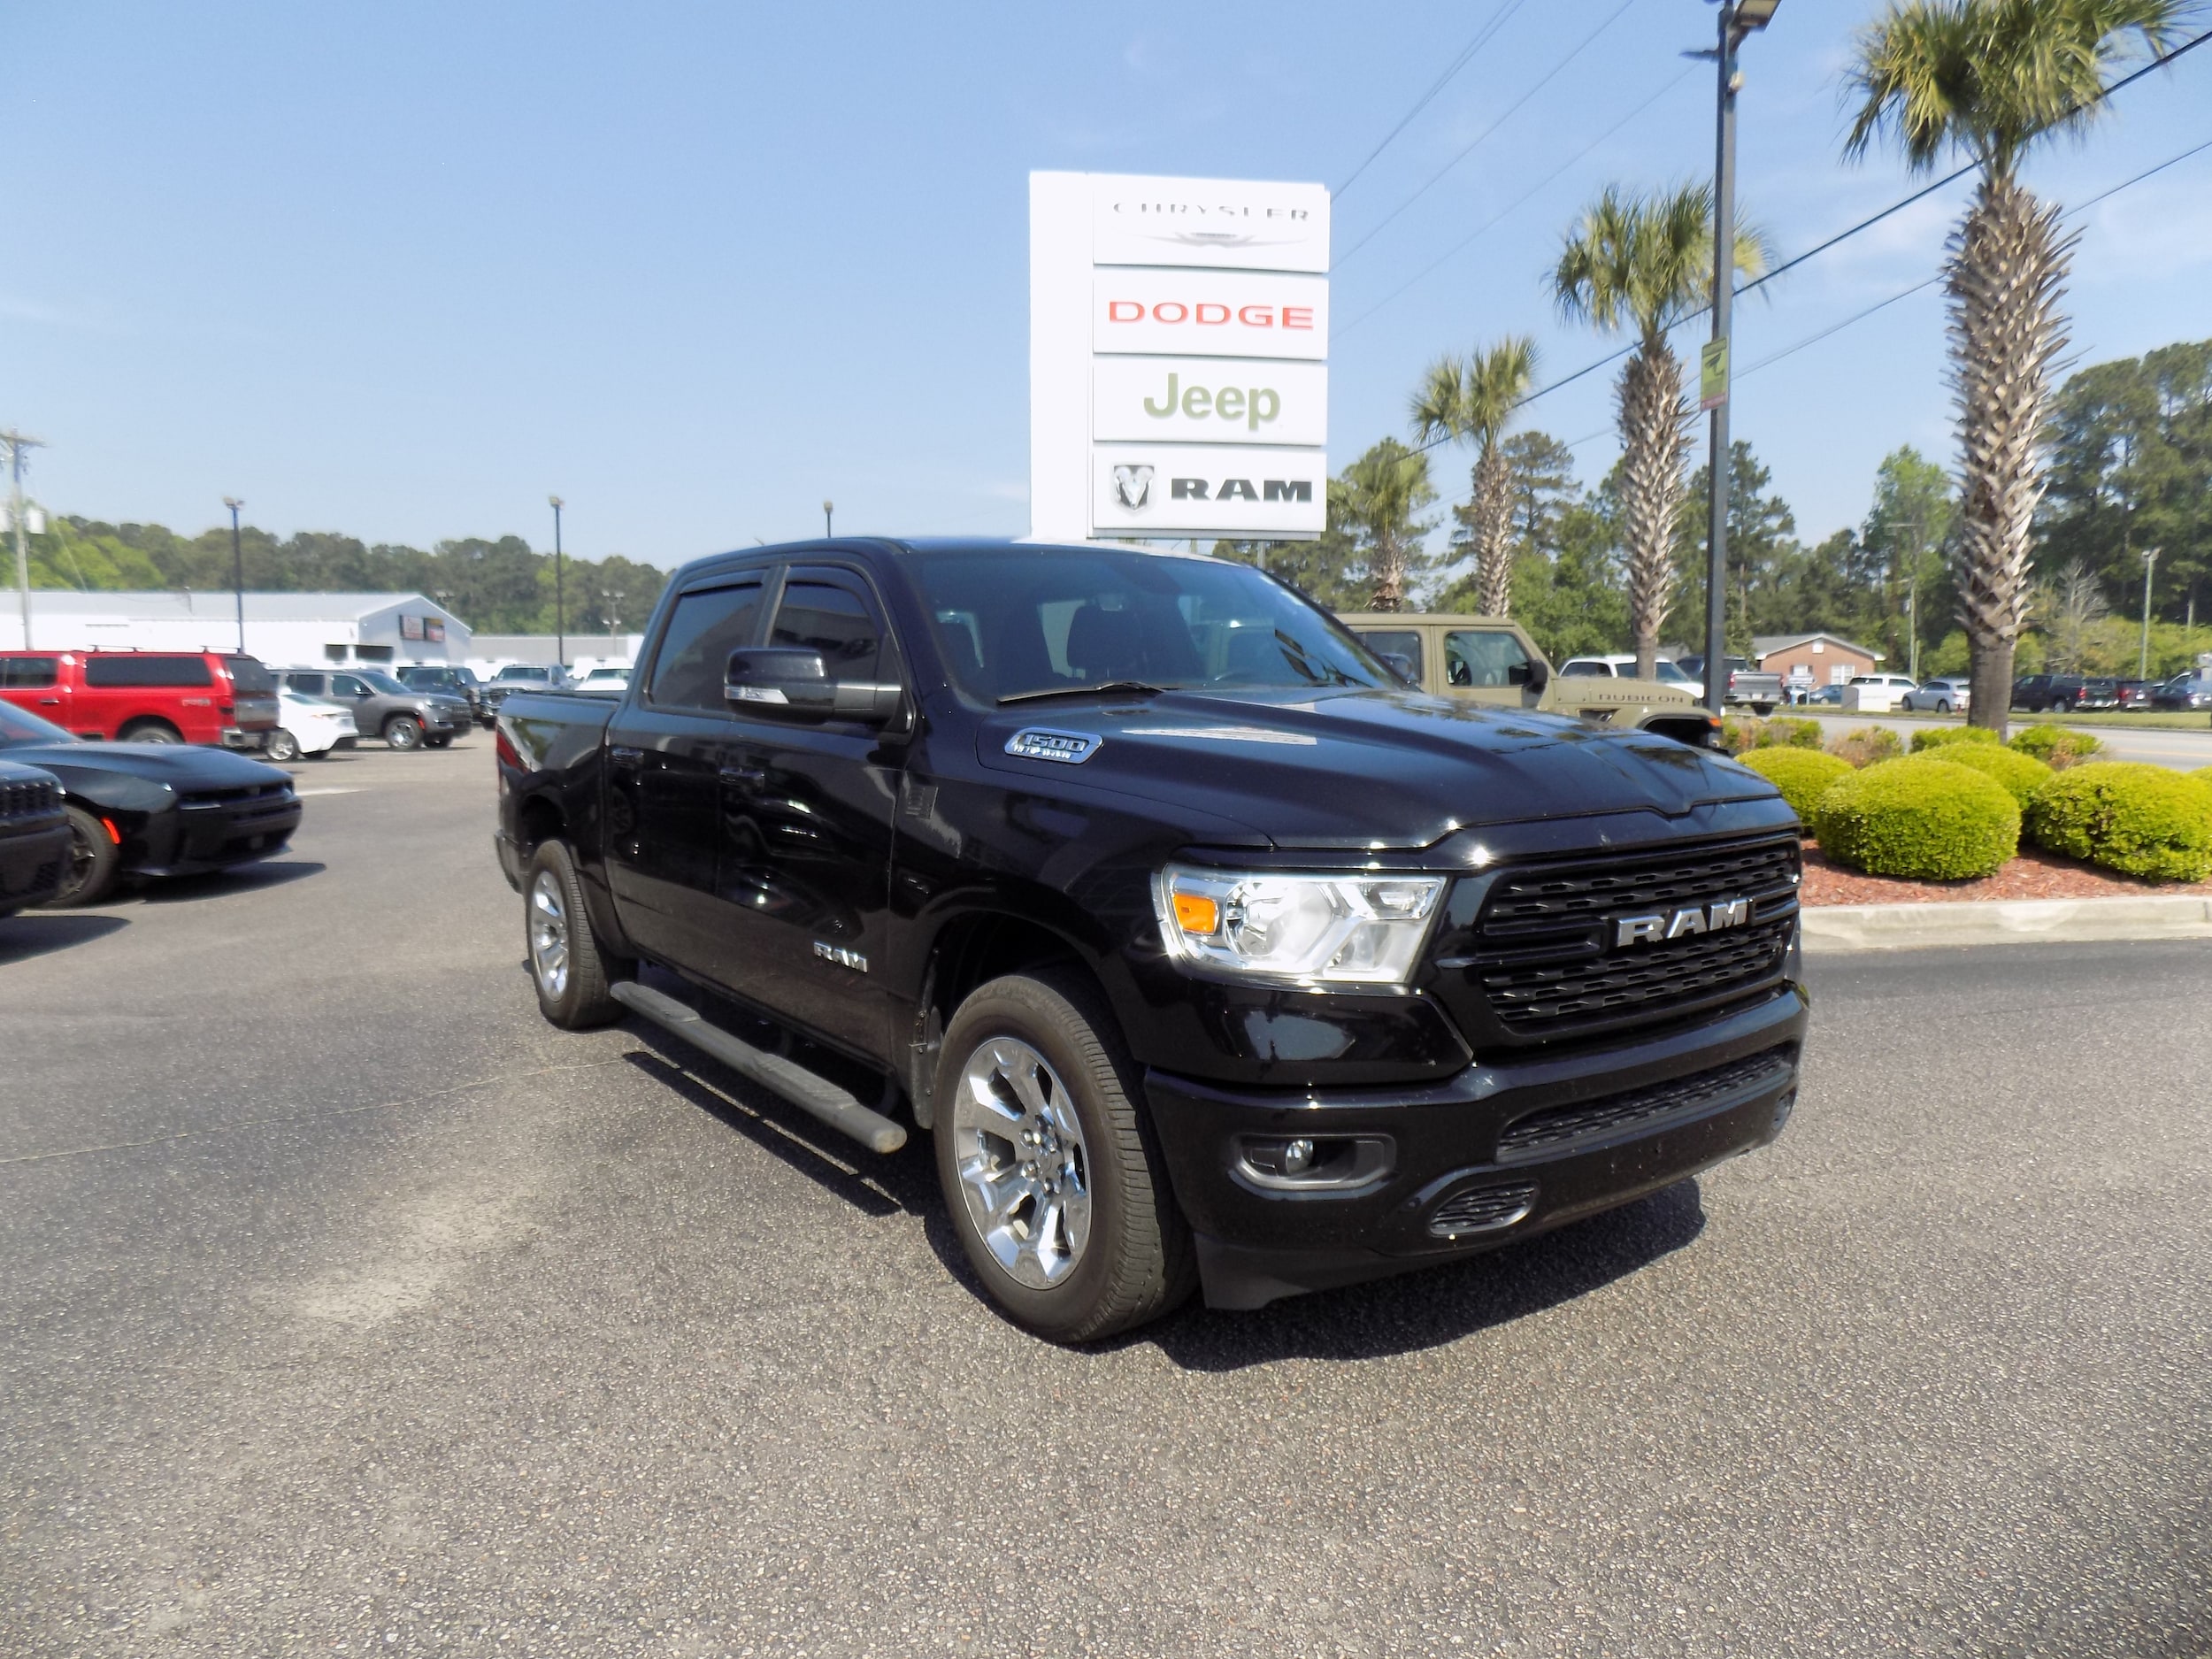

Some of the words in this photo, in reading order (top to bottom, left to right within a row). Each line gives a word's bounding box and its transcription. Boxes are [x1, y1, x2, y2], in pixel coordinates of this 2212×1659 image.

[1113, 203, 1309, 221] CHRYSLER
[1109, 302, 1314, 330] DODGE
[1143, 373, 1280, 432] Jeep
[1171, 478, 1313, 503] RAM
[1599, 694, 1683, 703] RUBICON
[1024, 733, 1086, 752] 1500
[1616, 898, 1748, 948] RAM
[813, 941, 868, 973] RAM
